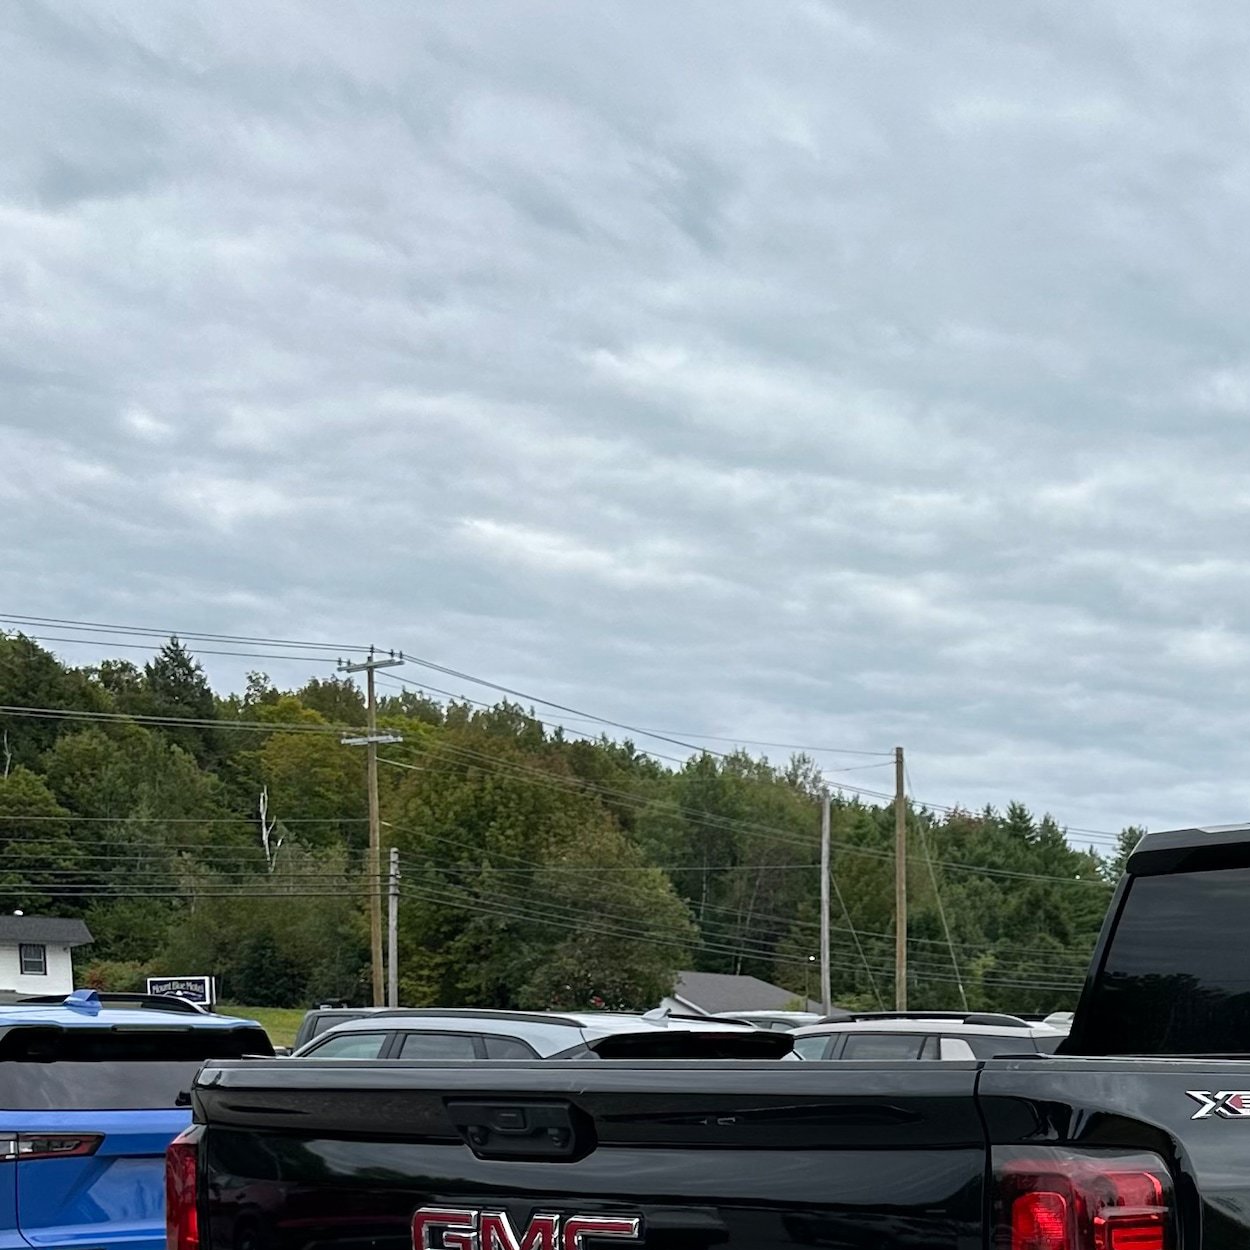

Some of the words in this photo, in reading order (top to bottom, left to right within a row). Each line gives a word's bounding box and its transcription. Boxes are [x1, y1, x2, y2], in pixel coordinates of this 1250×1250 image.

[151, 981, 171, 994] Mount
[172, 980, 186, 991] Blue
[186, 981, 204, 994] Motel
